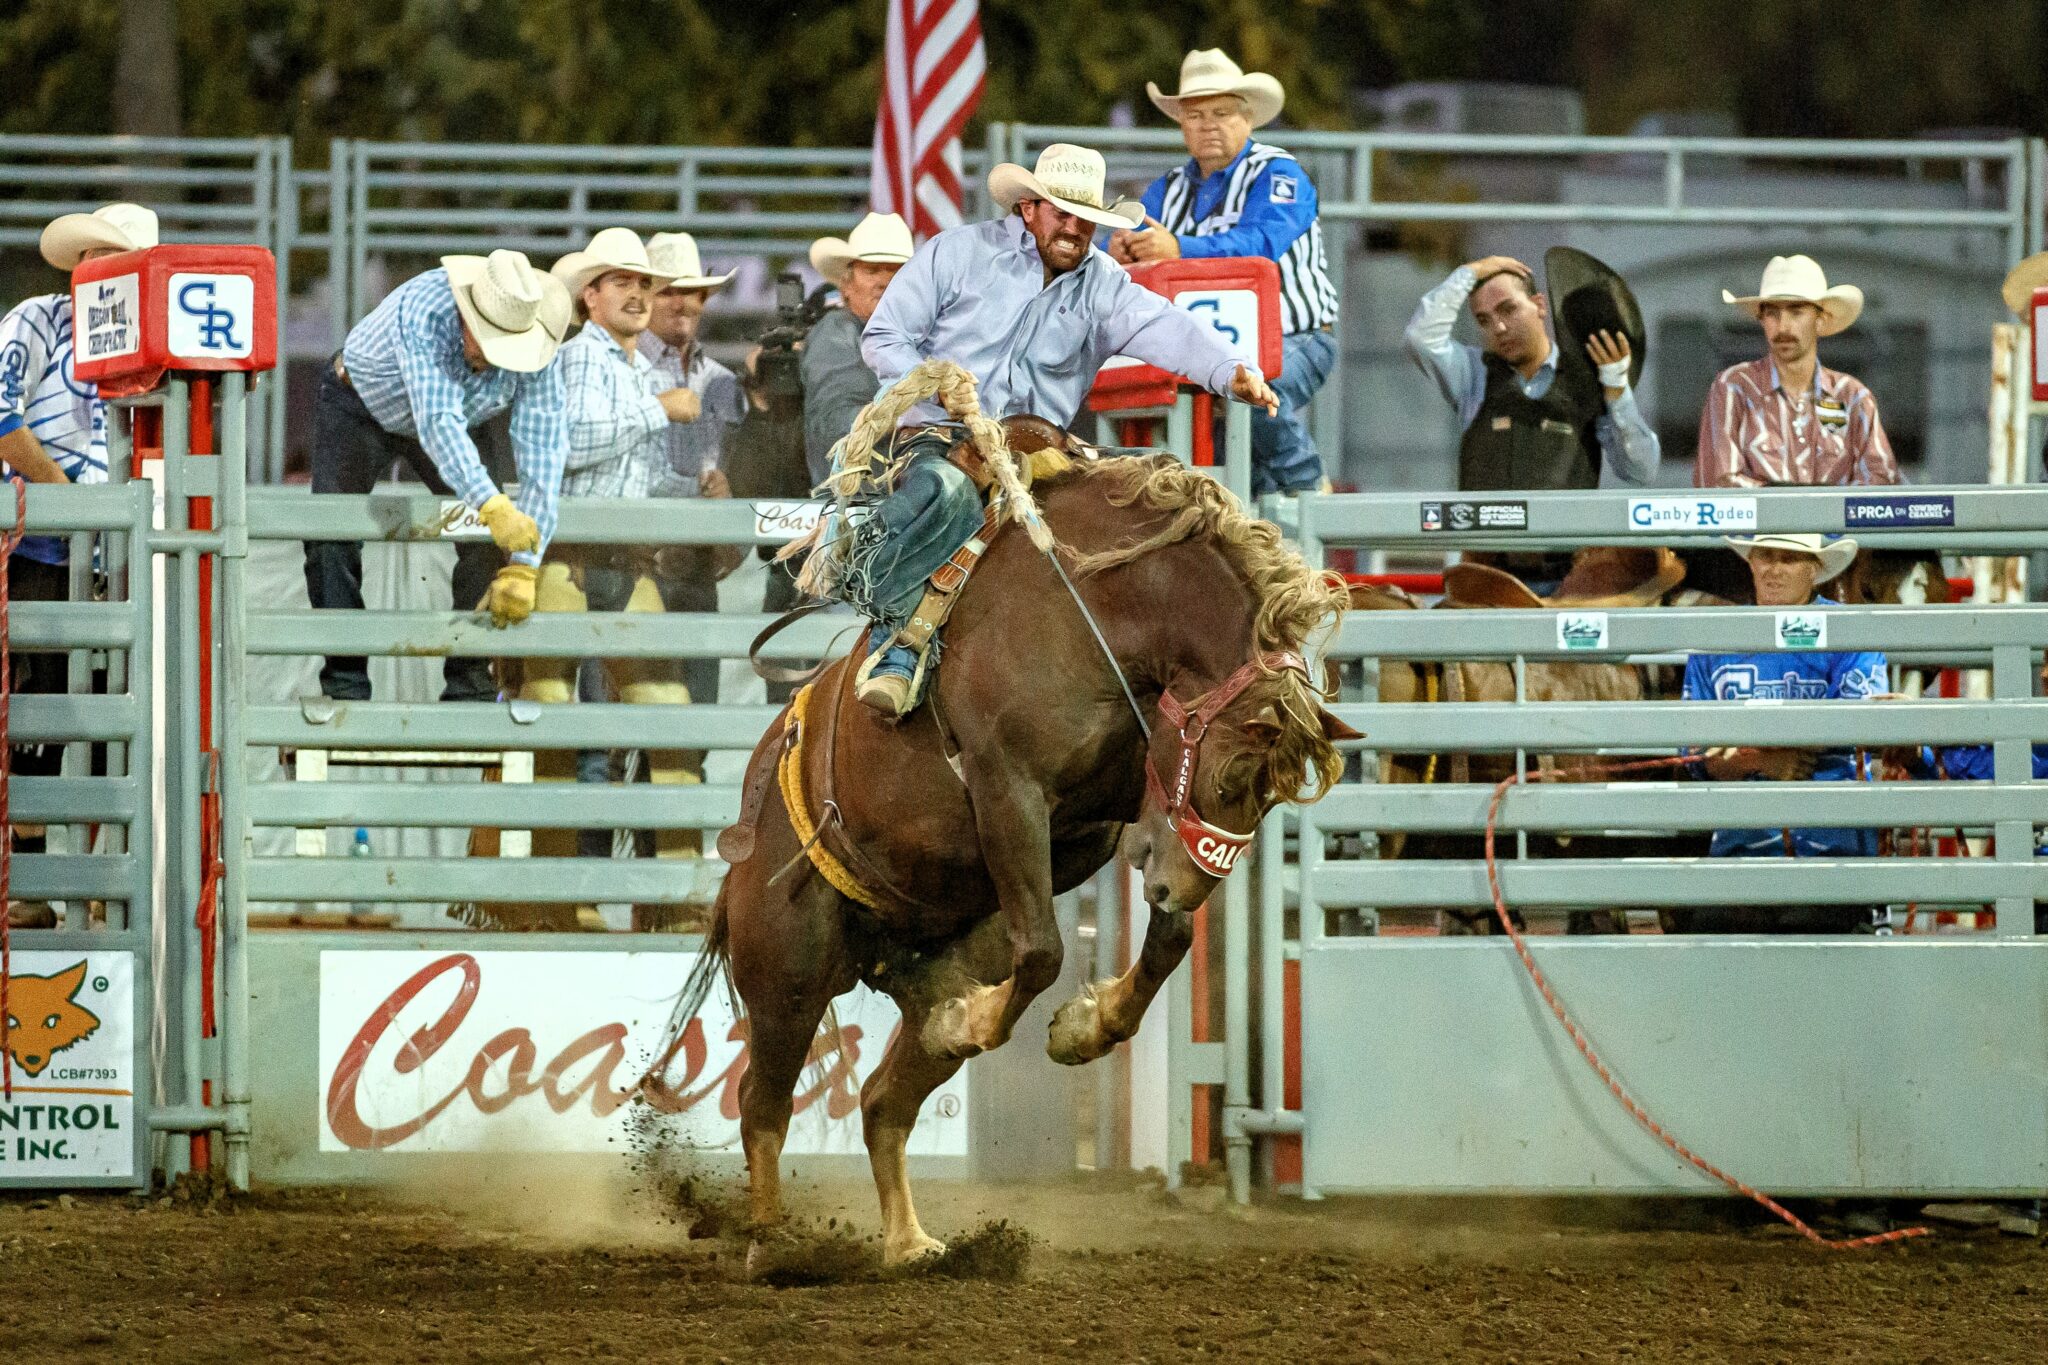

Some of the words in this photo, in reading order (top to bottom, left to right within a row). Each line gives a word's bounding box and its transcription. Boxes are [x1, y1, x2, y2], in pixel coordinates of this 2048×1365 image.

[1632, 503, 1691, 525] Canby
[1696, 502, 1755, 525] Rodeo
[1857, 505, 1894, 519] PRCA
[1176, 748, 1191, 807] CALGARY
[50, 1068, 118, 1080] LCB#7393
[17, 1137, 77, 1160] INC.
